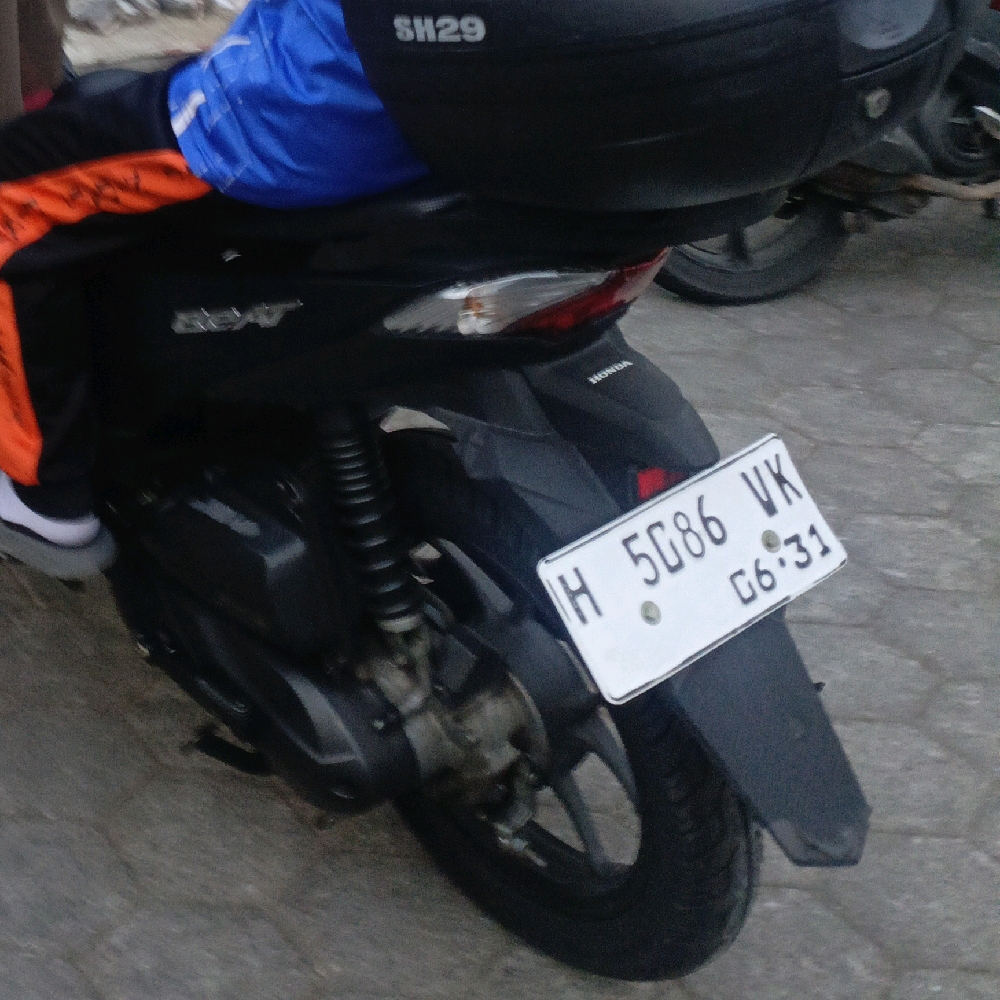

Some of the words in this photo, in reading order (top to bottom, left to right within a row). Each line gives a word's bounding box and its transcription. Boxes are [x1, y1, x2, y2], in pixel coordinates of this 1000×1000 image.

[393, 14, 486, 42] SH29
[588, 360, 634, 384] HONDA
[557, 566, 603, 625] H
[739, 453, 804, 518] VK
